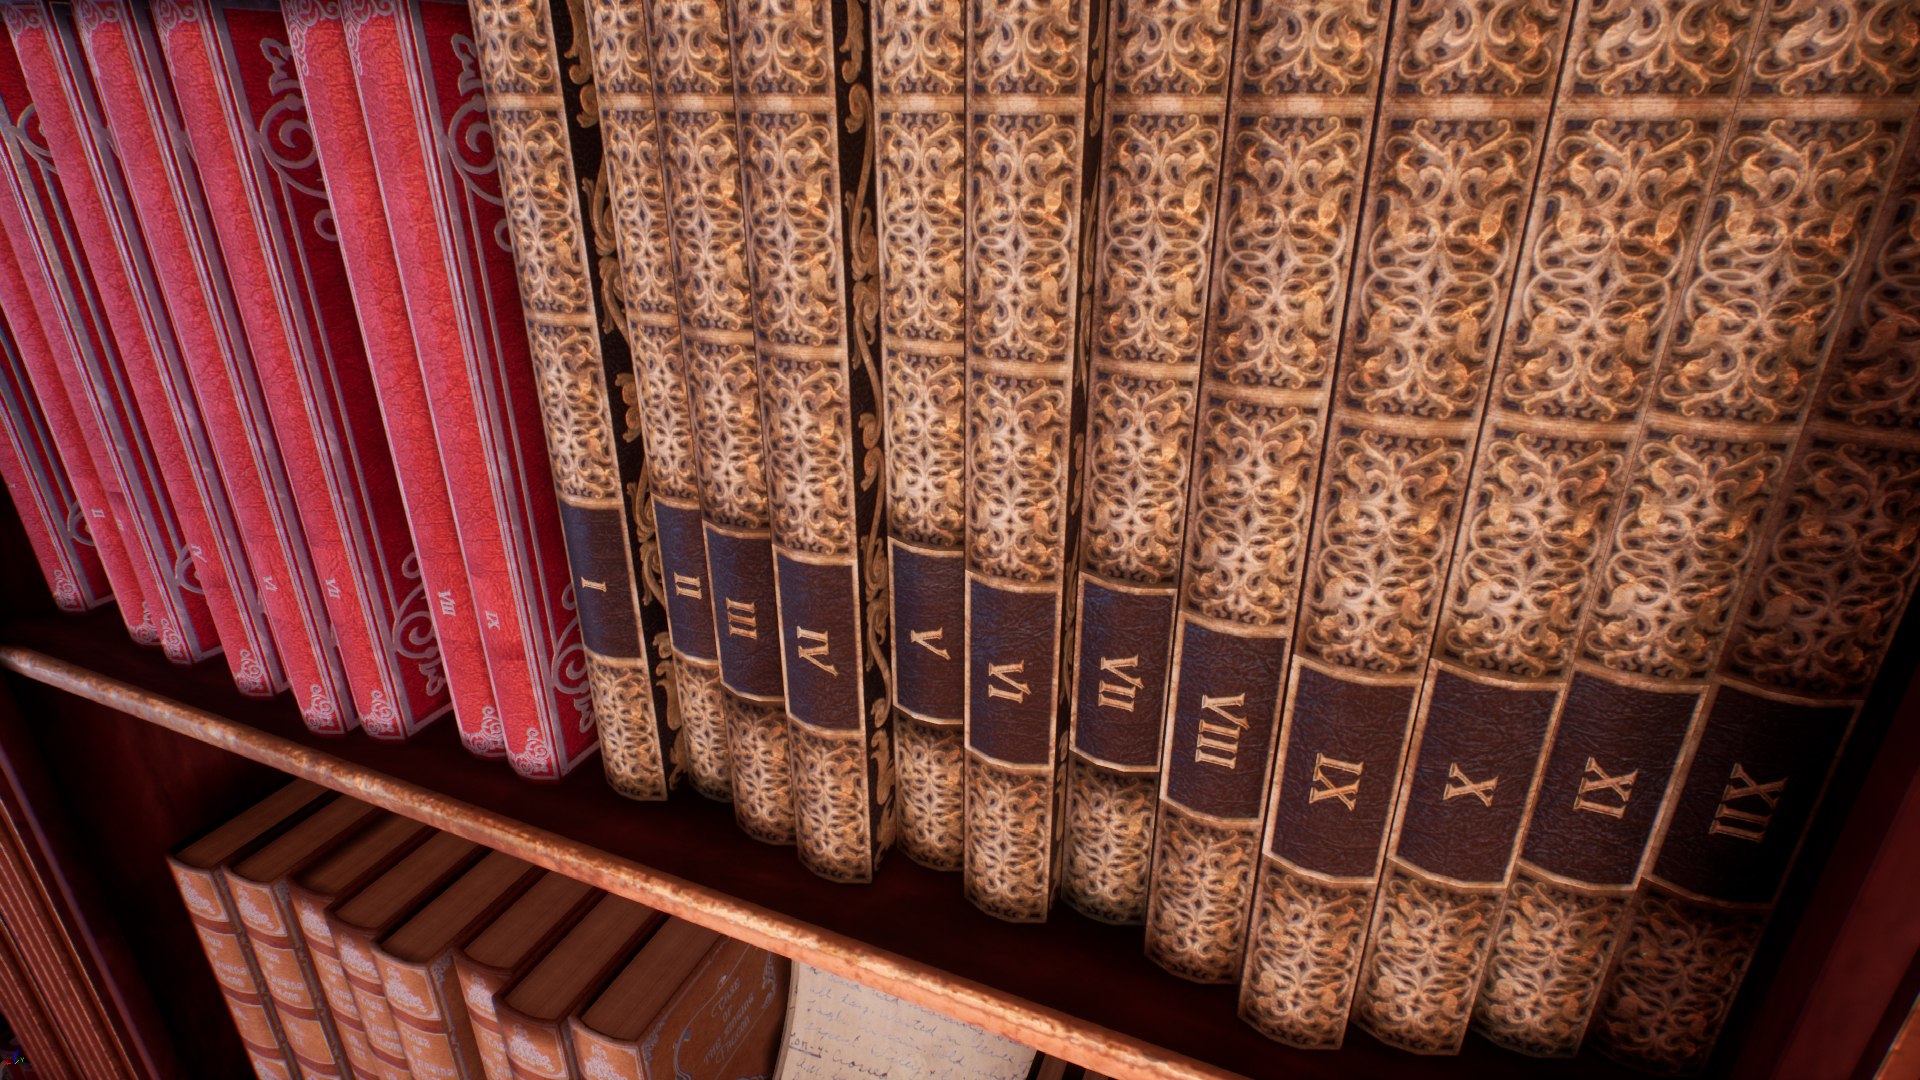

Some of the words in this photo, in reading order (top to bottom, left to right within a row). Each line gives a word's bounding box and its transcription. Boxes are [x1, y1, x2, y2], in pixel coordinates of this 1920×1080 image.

[191, 543, 208, 563] IV
[325, 578, 342, 600] VII
[437, 589, 457, 617] VIII
[581, 576, 607, 593] I
[673, 572, 703, 600] II
[484, 610, 501, 631] IX
[725, 597, 758, 640] III
[796, 625, 839, 678] IV
[910, 626, 951, 661] V
[988, 659, 1031, 705] VI
[1097, 653, 1144, 713] VII
[1194, 691, 1250, 770] VIII
[1308, 752, 1365, 812] IX
[1442, 762, 1500, 808] X
[1573, 755, 1639, 819] XI
[1708, 761, 1788, 843] XII
